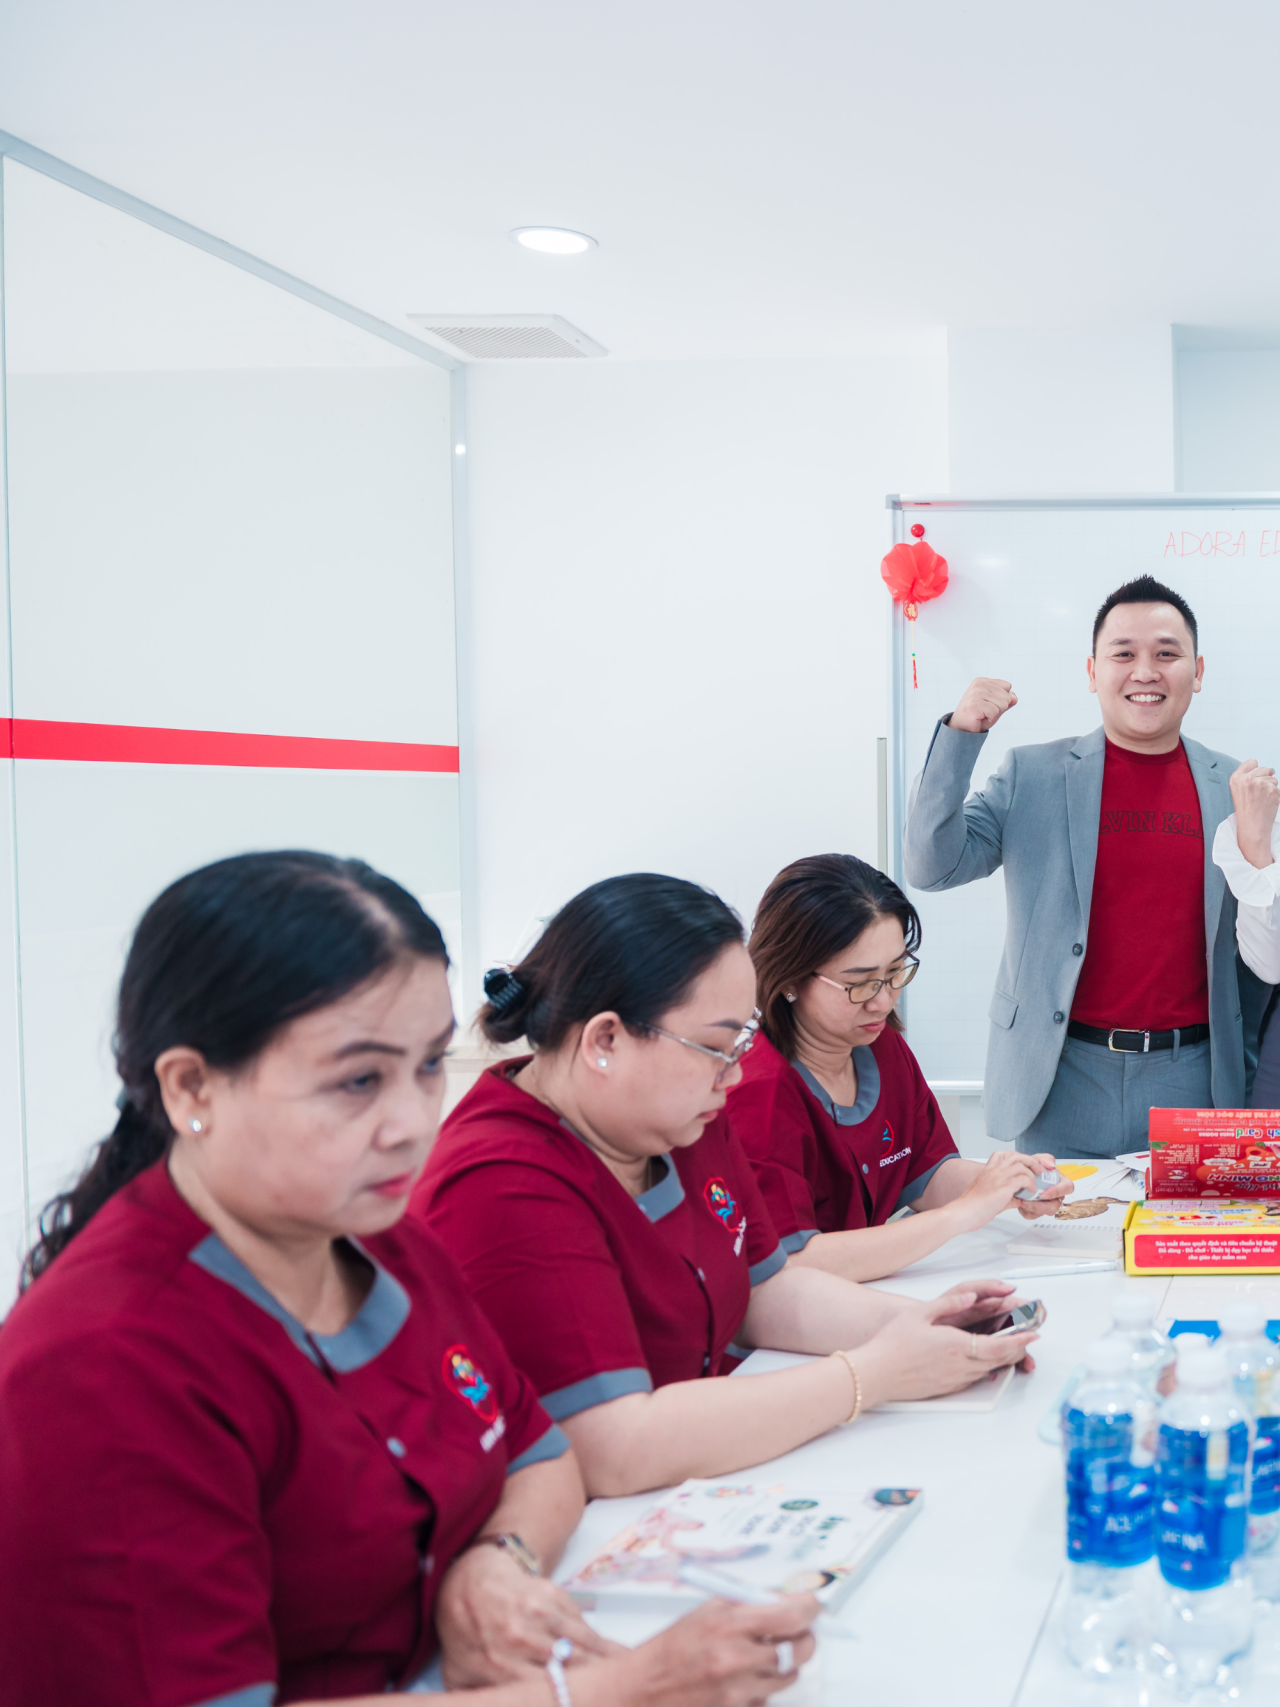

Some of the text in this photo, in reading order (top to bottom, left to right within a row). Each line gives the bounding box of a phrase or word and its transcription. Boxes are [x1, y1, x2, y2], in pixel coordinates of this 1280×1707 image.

[1163, 531, 1247, 558] ADORA
[1235, 1128, 1264, 1139] Card
[880, 1147, 912, 1168] EDUCATION
[1206, 1173, 1254, 1183] MINH
